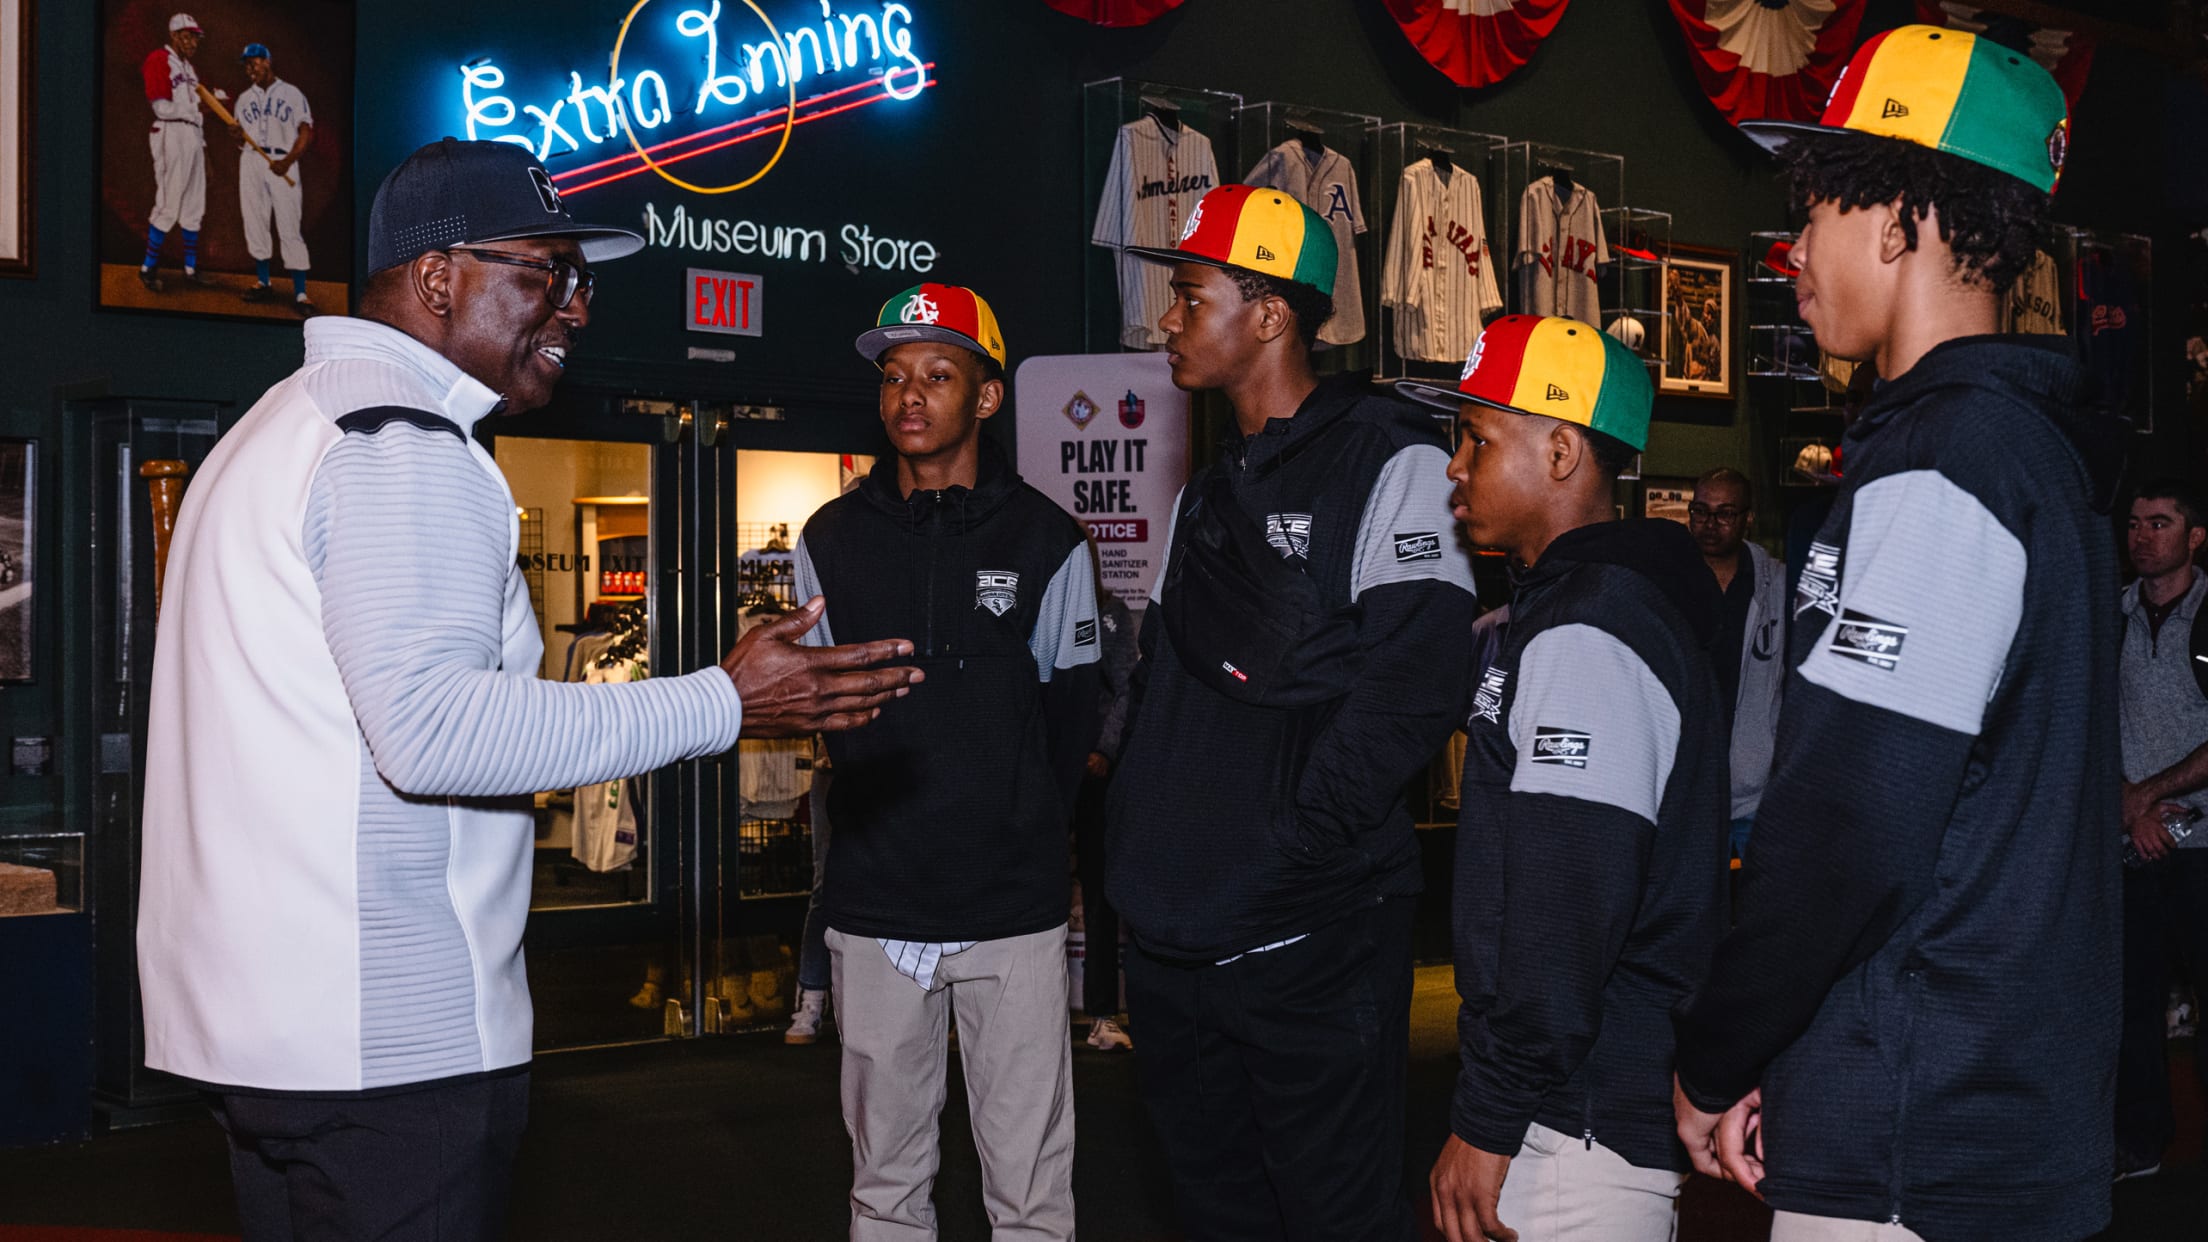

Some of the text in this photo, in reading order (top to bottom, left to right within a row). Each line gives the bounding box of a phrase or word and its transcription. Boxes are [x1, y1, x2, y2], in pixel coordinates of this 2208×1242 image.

[461, 0, 926, 162] Extra Inning
[243, 97, 293, 125] GRAYS
[1323, 183, 1353, 223] A
[648, 203, 937, 273] Museum Store
[1168, 199, 1177, 249] NATIO
[695, 276, 754, 330] EXIT
[1061, 439, 1147, 474] PLAY IT
[1073, 480, 1137, 514] SAFE.
[1088, 523, 1137, 538] OTICE
[604, 555, 645, 572] XIT
[741, 559, 795, 577] MUSE
[1101, 549, 1128, 558] HAND
[1101, 559, 1149, 569] SANITIZER
[1101, 570, 1140, 579] STATION
